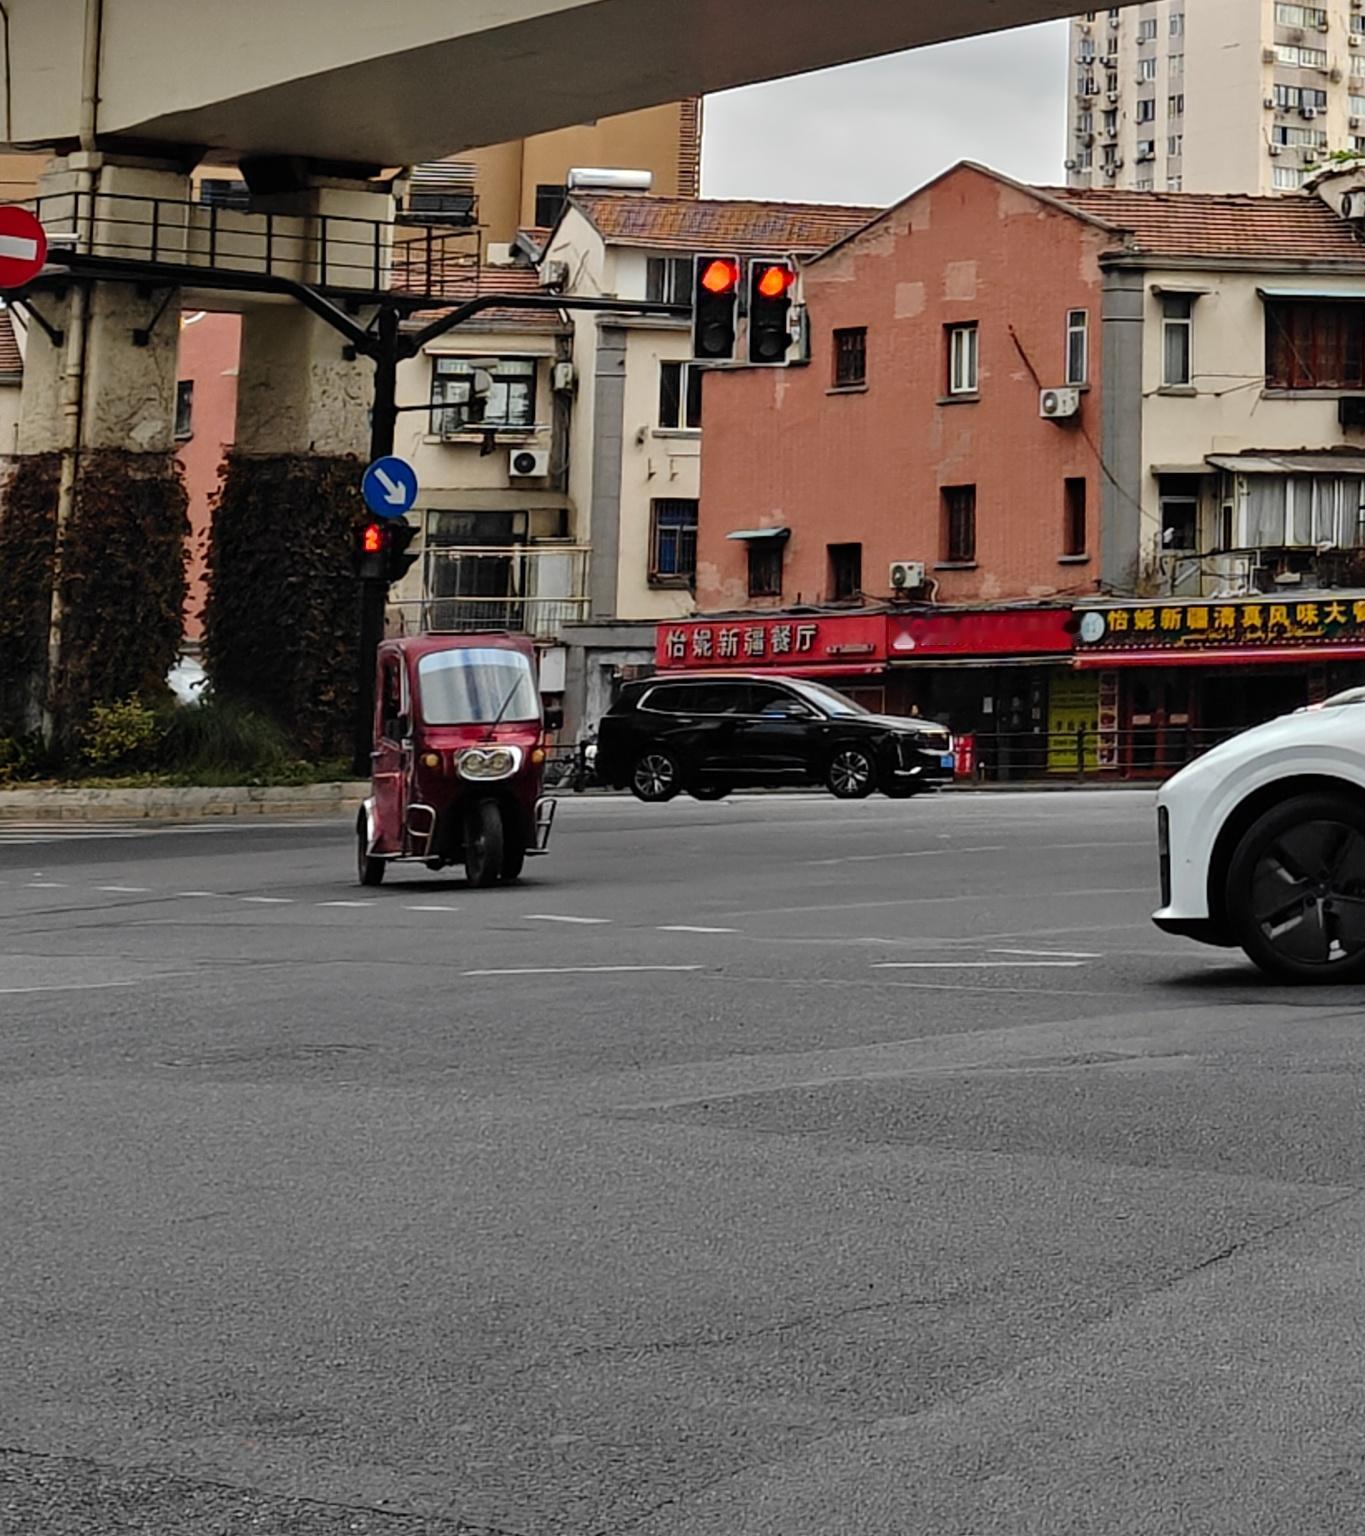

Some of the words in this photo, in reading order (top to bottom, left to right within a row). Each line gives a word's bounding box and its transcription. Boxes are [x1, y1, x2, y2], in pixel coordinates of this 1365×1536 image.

[665, 624, 817, 658] 怡妮新疆餐厅
